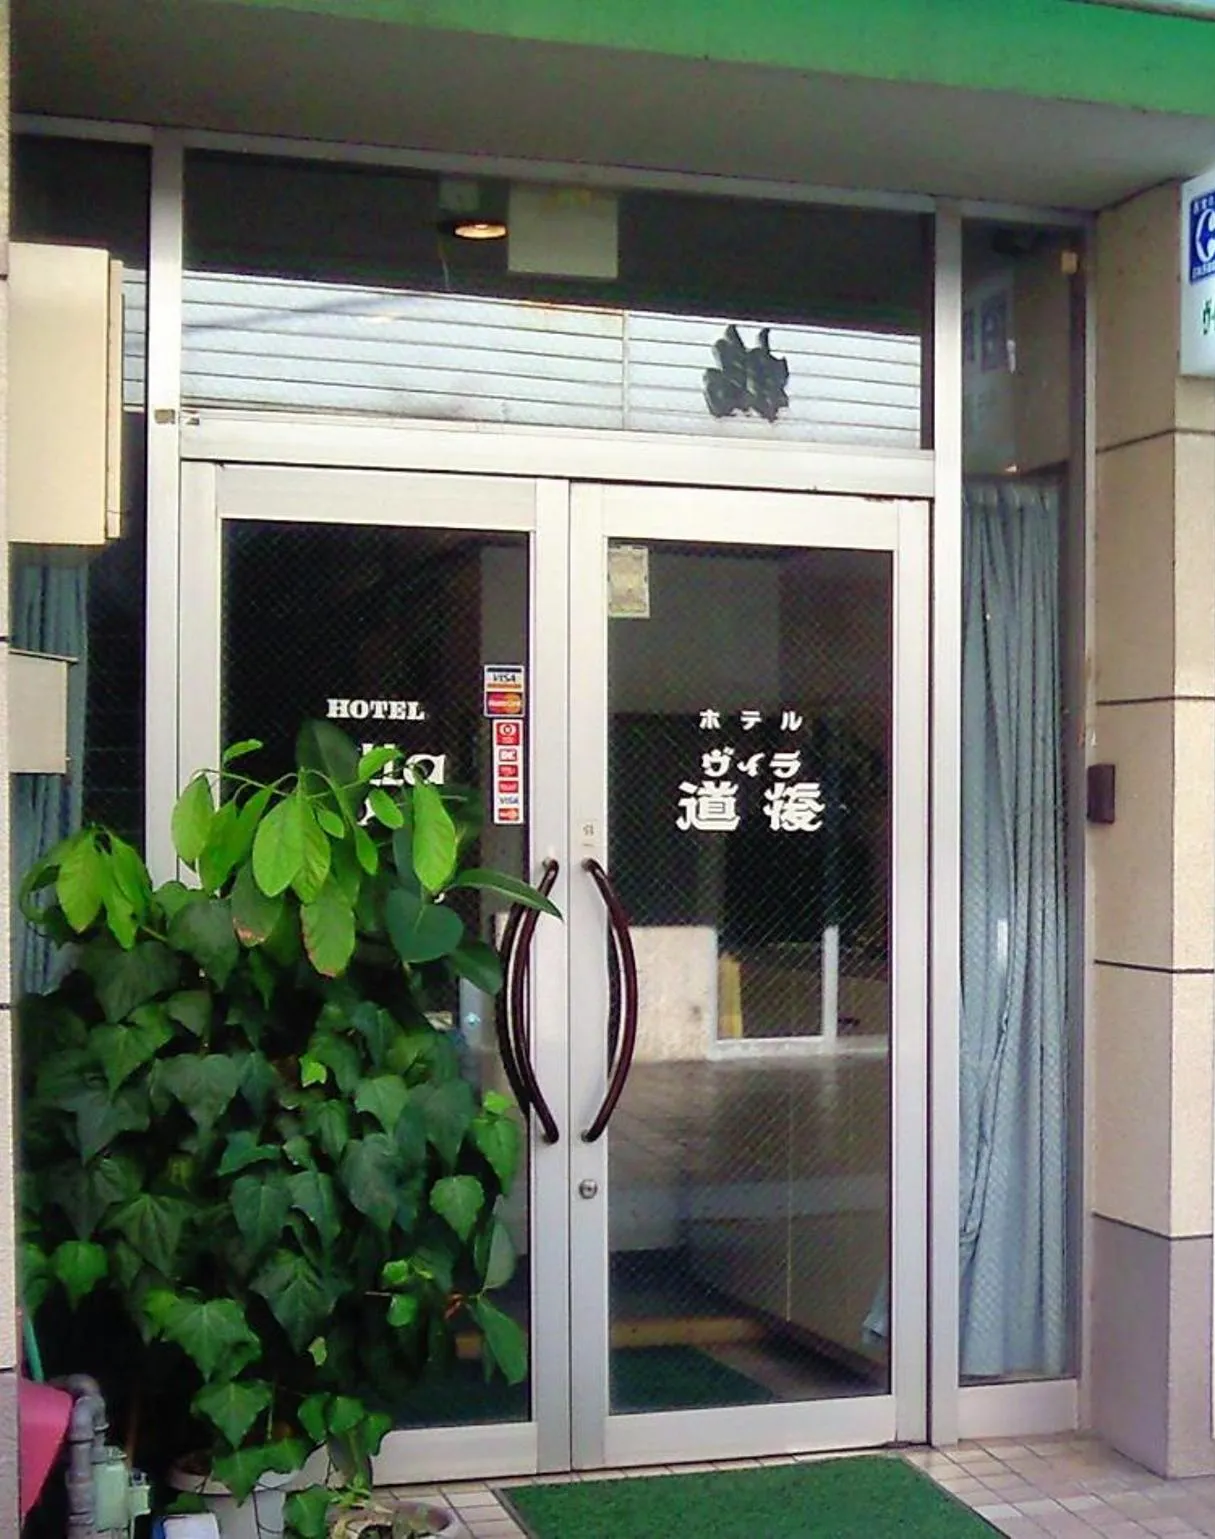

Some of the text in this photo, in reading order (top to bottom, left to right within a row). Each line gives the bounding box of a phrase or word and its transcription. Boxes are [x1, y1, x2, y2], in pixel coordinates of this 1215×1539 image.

[326, 698, 426, 721] HOTEL
[699, 708, 803, 731] ホテル
[675, 780, 825, 831] 道後
